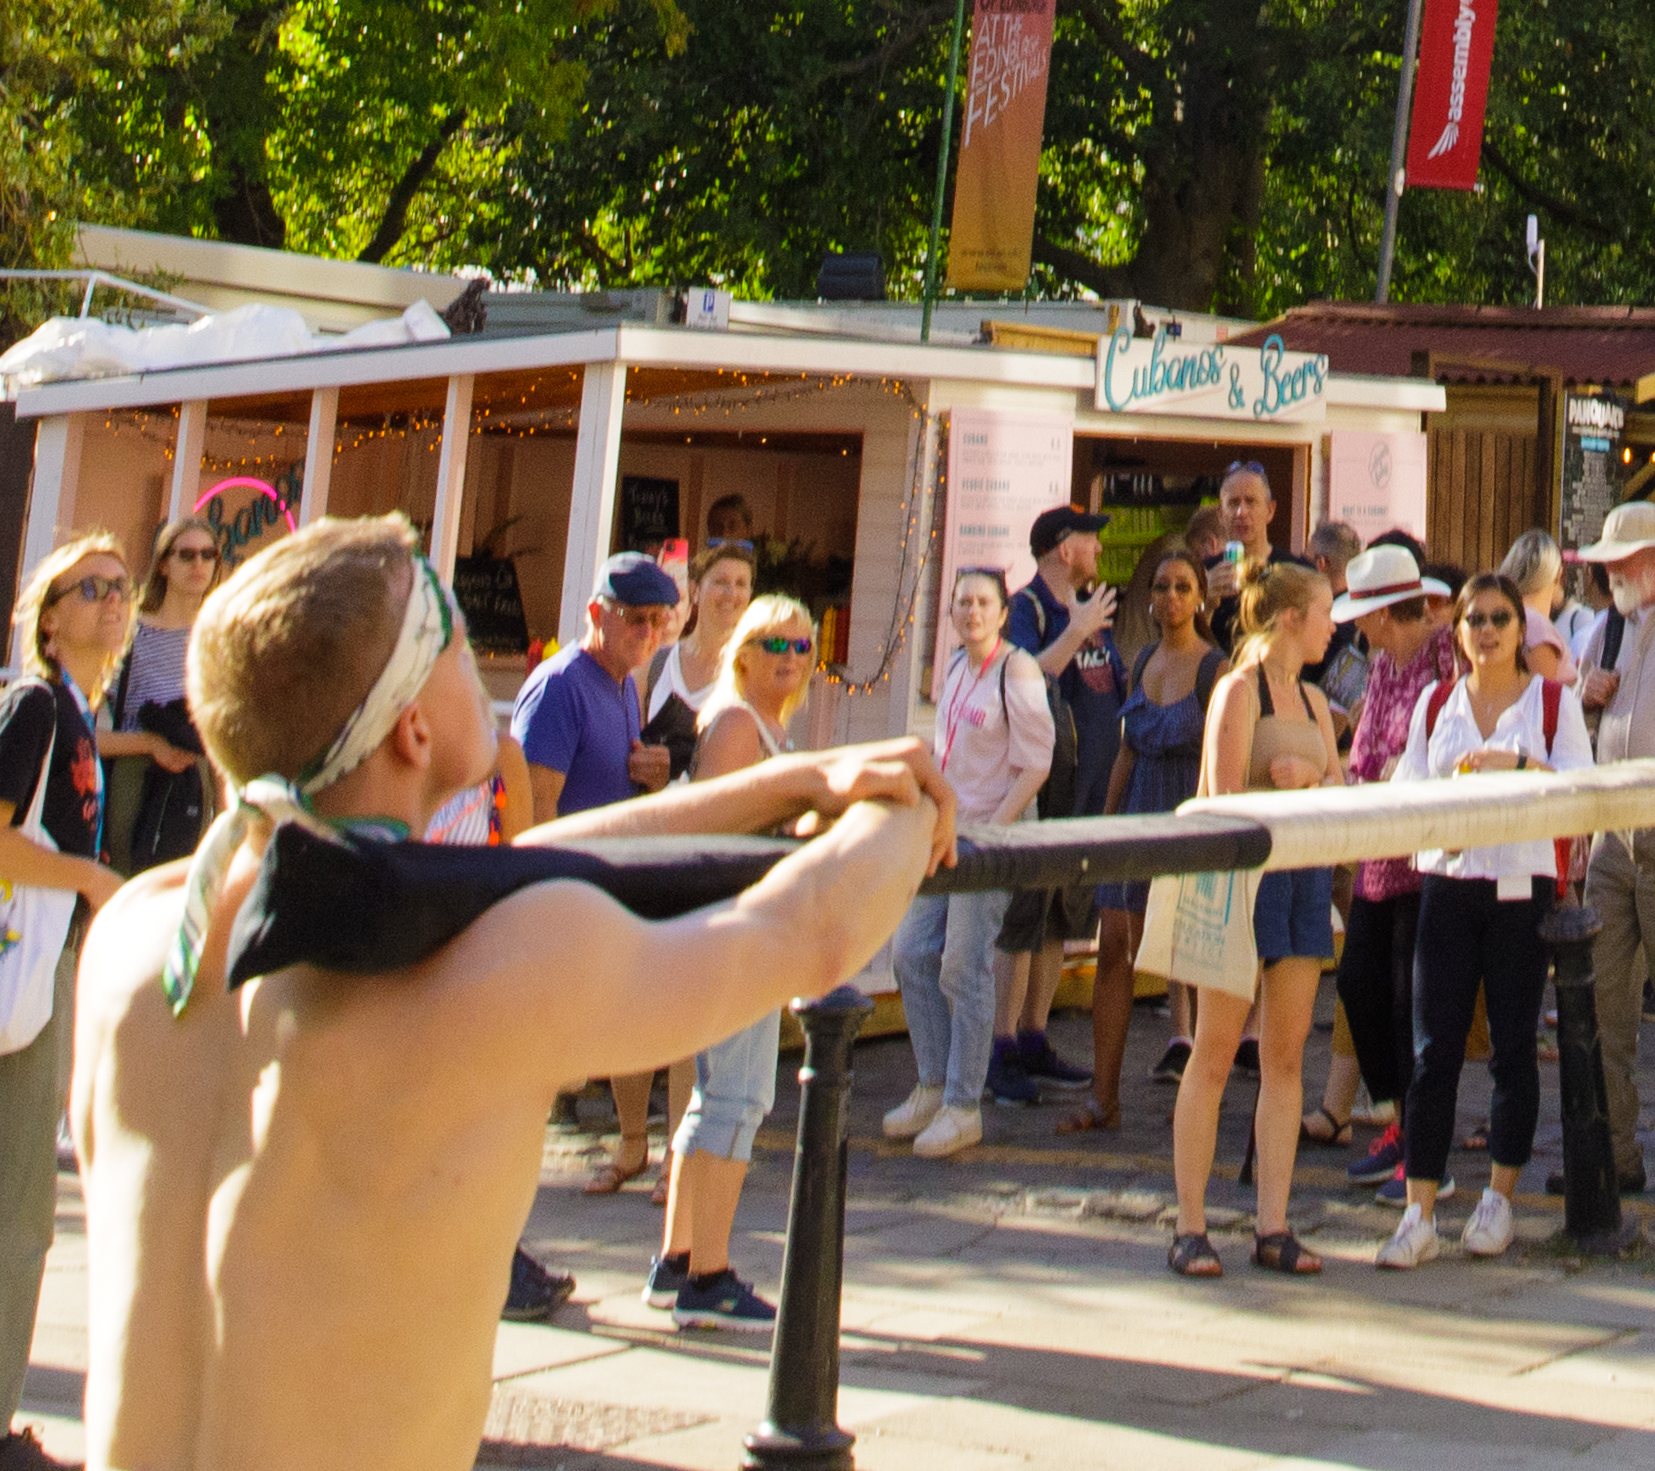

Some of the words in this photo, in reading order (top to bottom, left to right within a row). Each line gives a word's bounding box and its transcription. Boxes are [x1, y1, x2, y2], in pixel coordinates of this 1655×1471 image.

[975, 13, 1000, 50] AT
[1448, 4, 1476, 123] assembly
[1104, 325, 1226, 413] Cubanos
[1228, 362, 1245, 410] &
[1253, 333, 1329, 420] Beers
